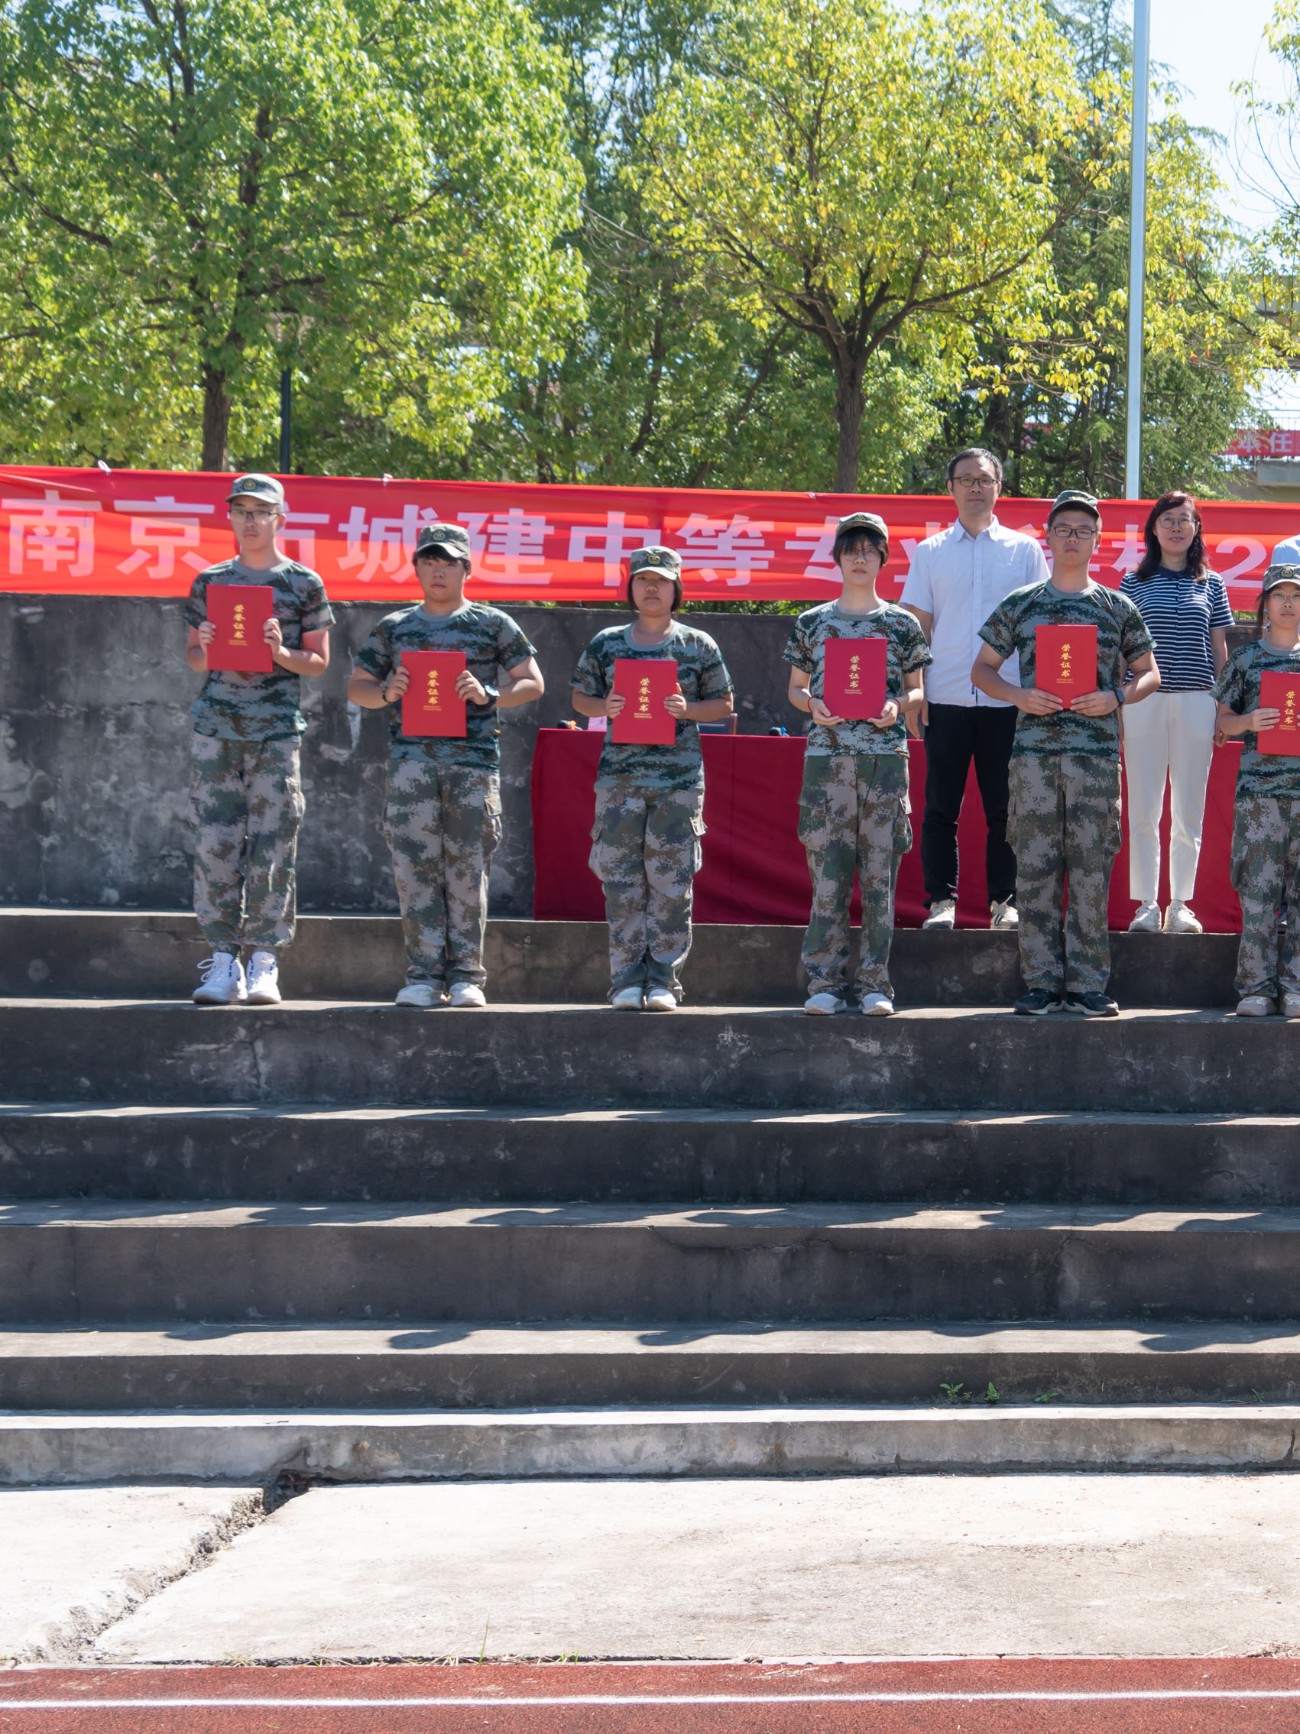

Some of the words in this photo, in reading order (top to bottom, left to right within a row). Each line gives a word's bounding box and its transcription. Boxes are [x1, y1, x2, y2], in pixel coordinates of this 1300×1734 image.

[232, 604, 246, 639] 荣誉证书
[848, 656, 861, 688] 荣誉证书
[1059, 644, 1073, 677] 荣誉证书
[426, 670, 440, 704] 荣誉证书
[638, 678, 651, 712] 荣誉证书
[1283, 691, 1296, 724] 荣誉证书
